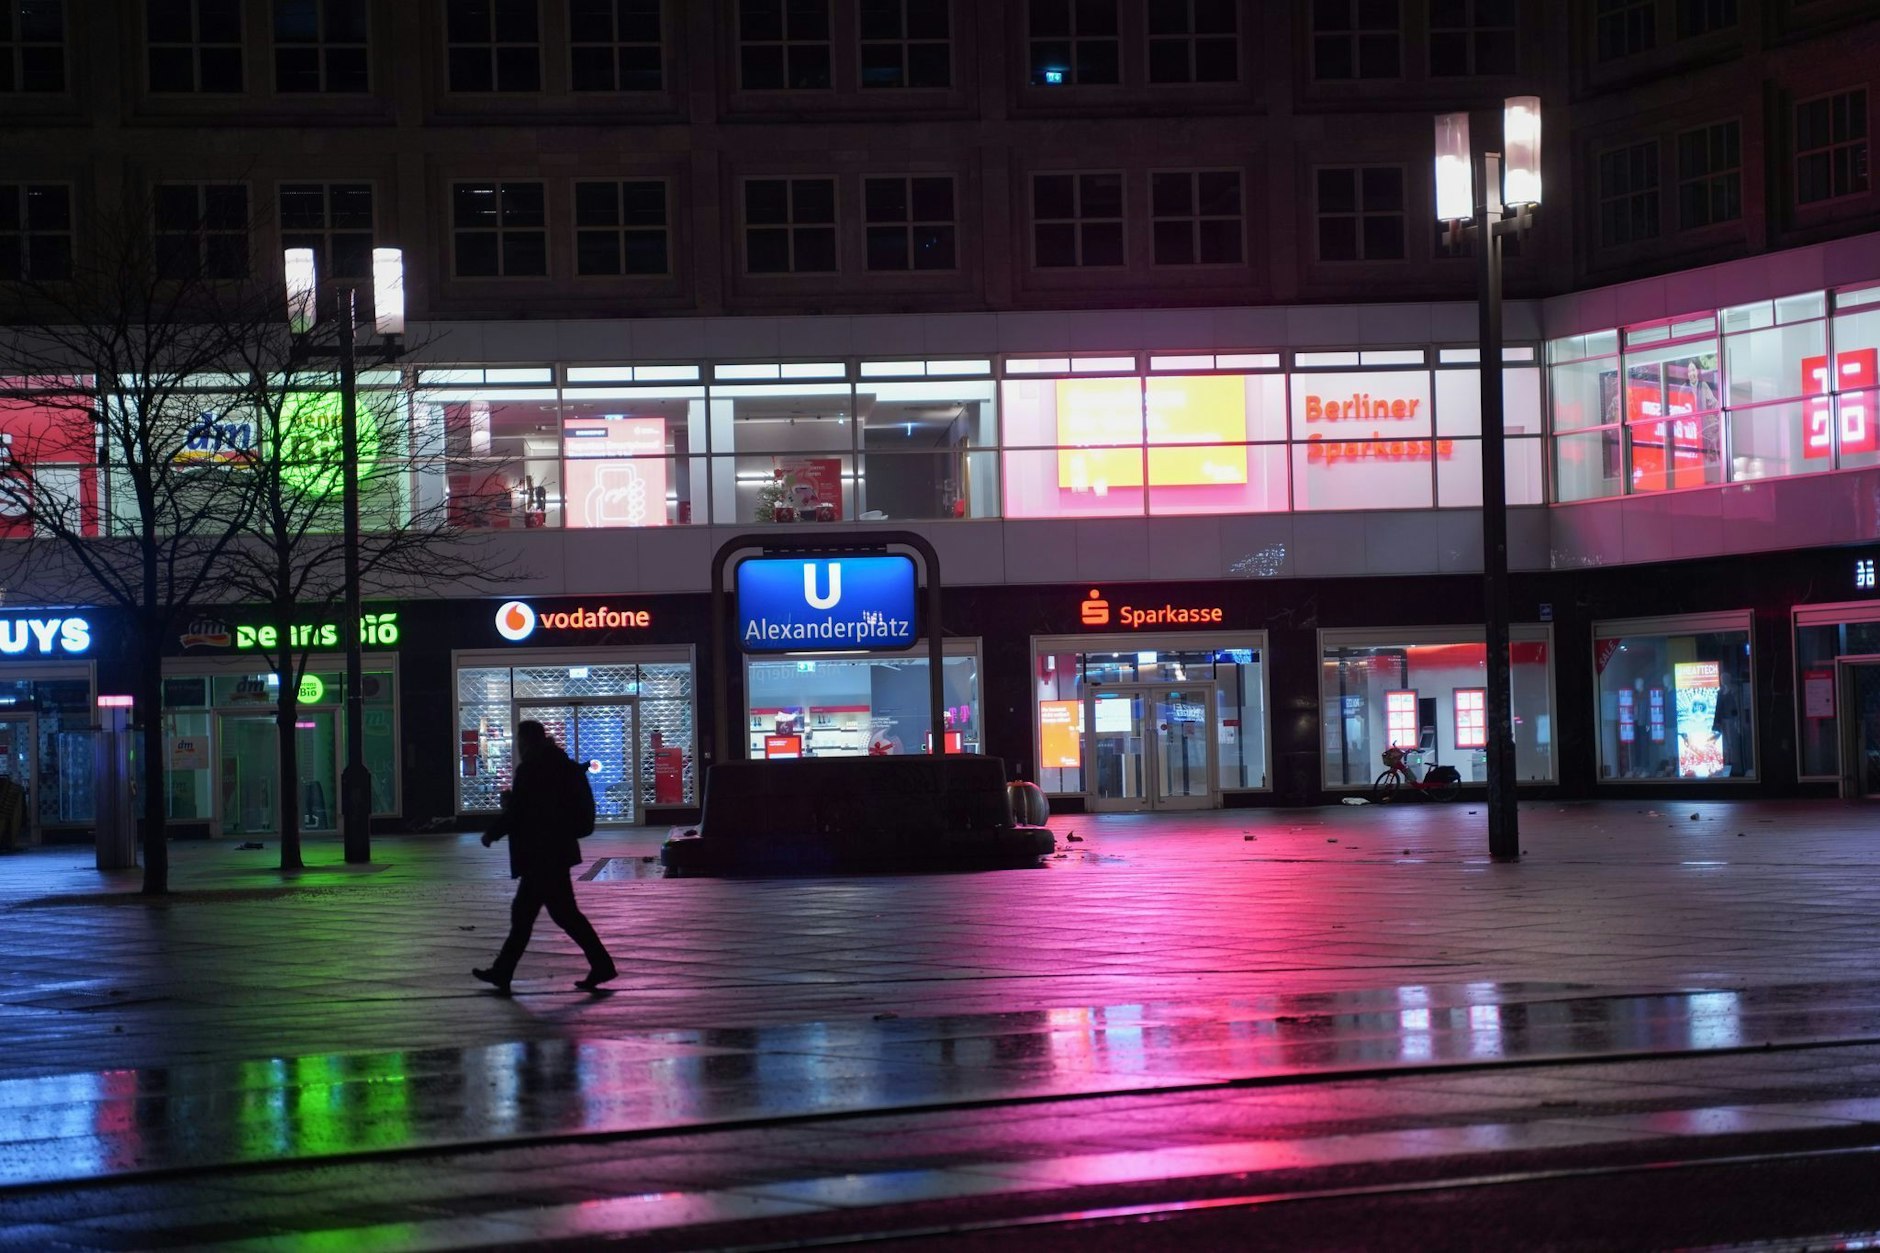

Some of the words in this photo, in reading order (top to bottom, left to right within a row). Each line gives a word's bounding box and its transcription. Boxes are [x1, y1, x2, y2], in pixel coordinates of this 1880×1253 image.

[1306, 393, 1420, 422] Berliner
[187, 411, 251, 451] dm
[1307, 431, 1454, 465] Sparkasse
[803, 563, 841, 610] U
[540, 607, 650, 629] vodafone
[744, 616, 909, 643] Alexanderplatz
[1120, 604, 1223, 628] Sparkasse
[0, 618, 91, 654] UYS
[1598, 639, 1616, 668] SALE
[236, 676, 265, 692] dm
[177, 740, 193, 750] dm
